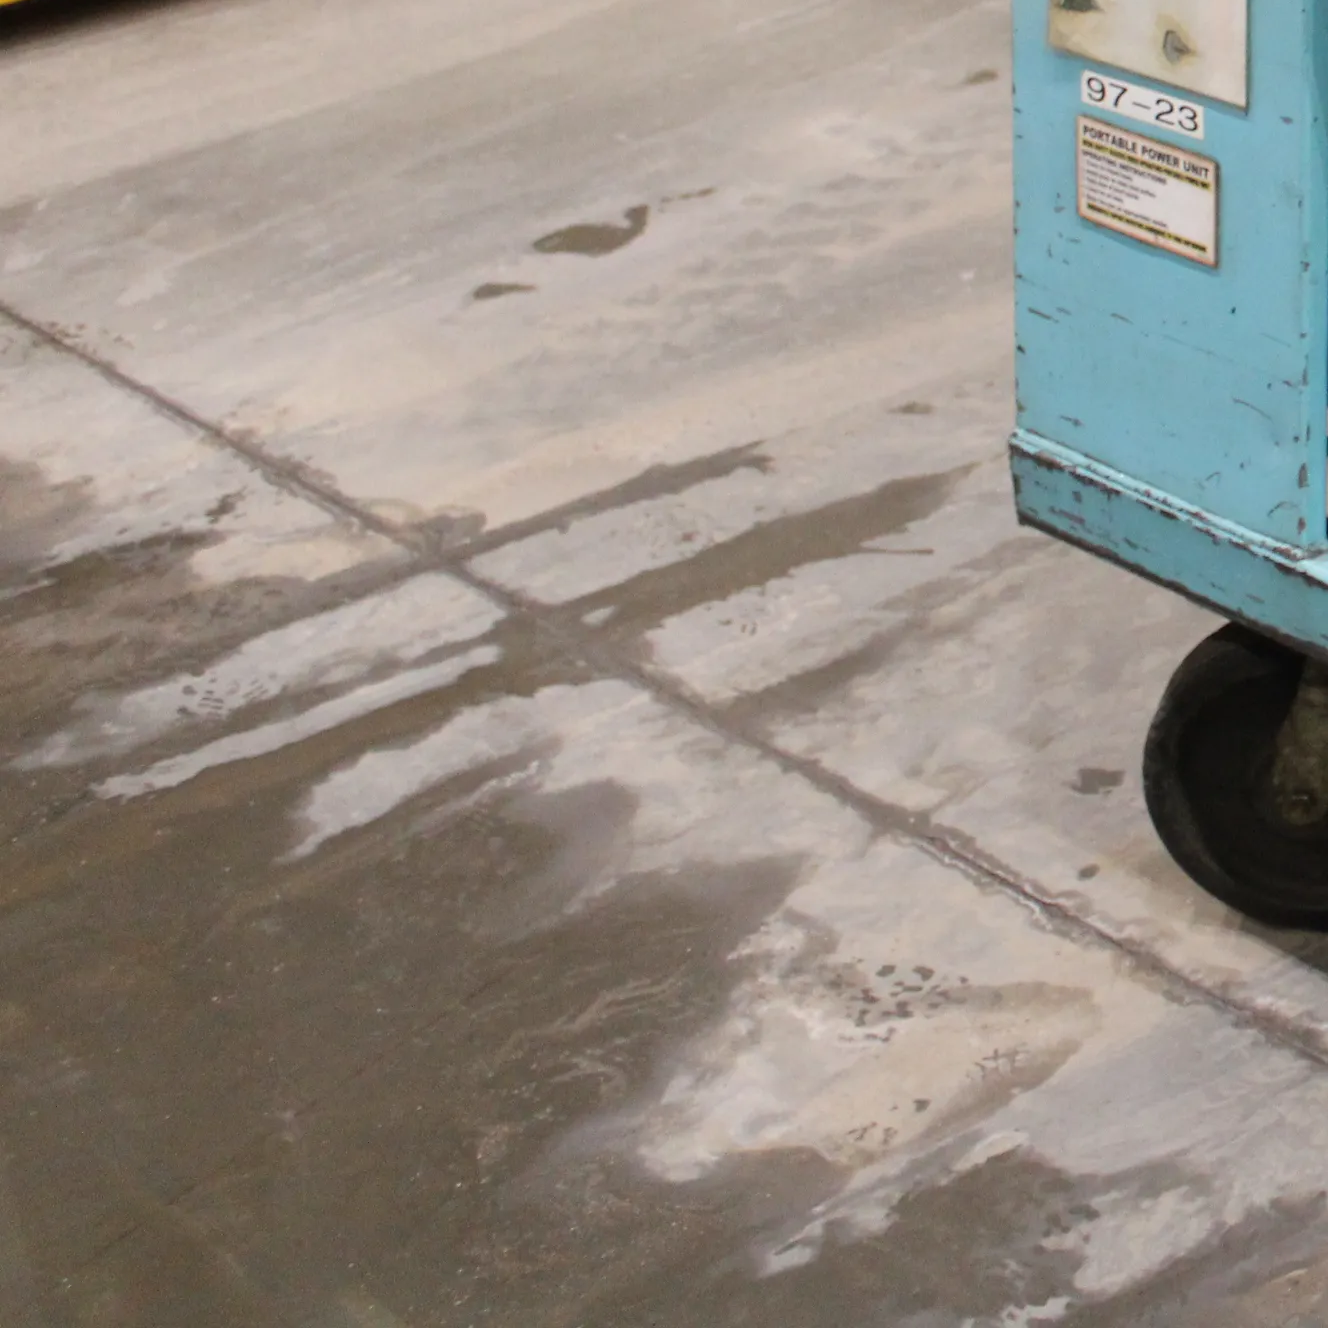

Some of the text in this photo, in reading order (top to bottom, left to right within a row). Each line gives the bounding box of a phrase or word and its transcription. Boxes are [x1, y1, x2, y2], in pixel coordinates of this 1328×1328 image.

[1086, 77, 1198, 132] 97-23
[1083, 125, 1138, 154] PORTABLE
[1141, 145, 1180, 169] POWER
[1183, 160, 1210, 179] UNIT
